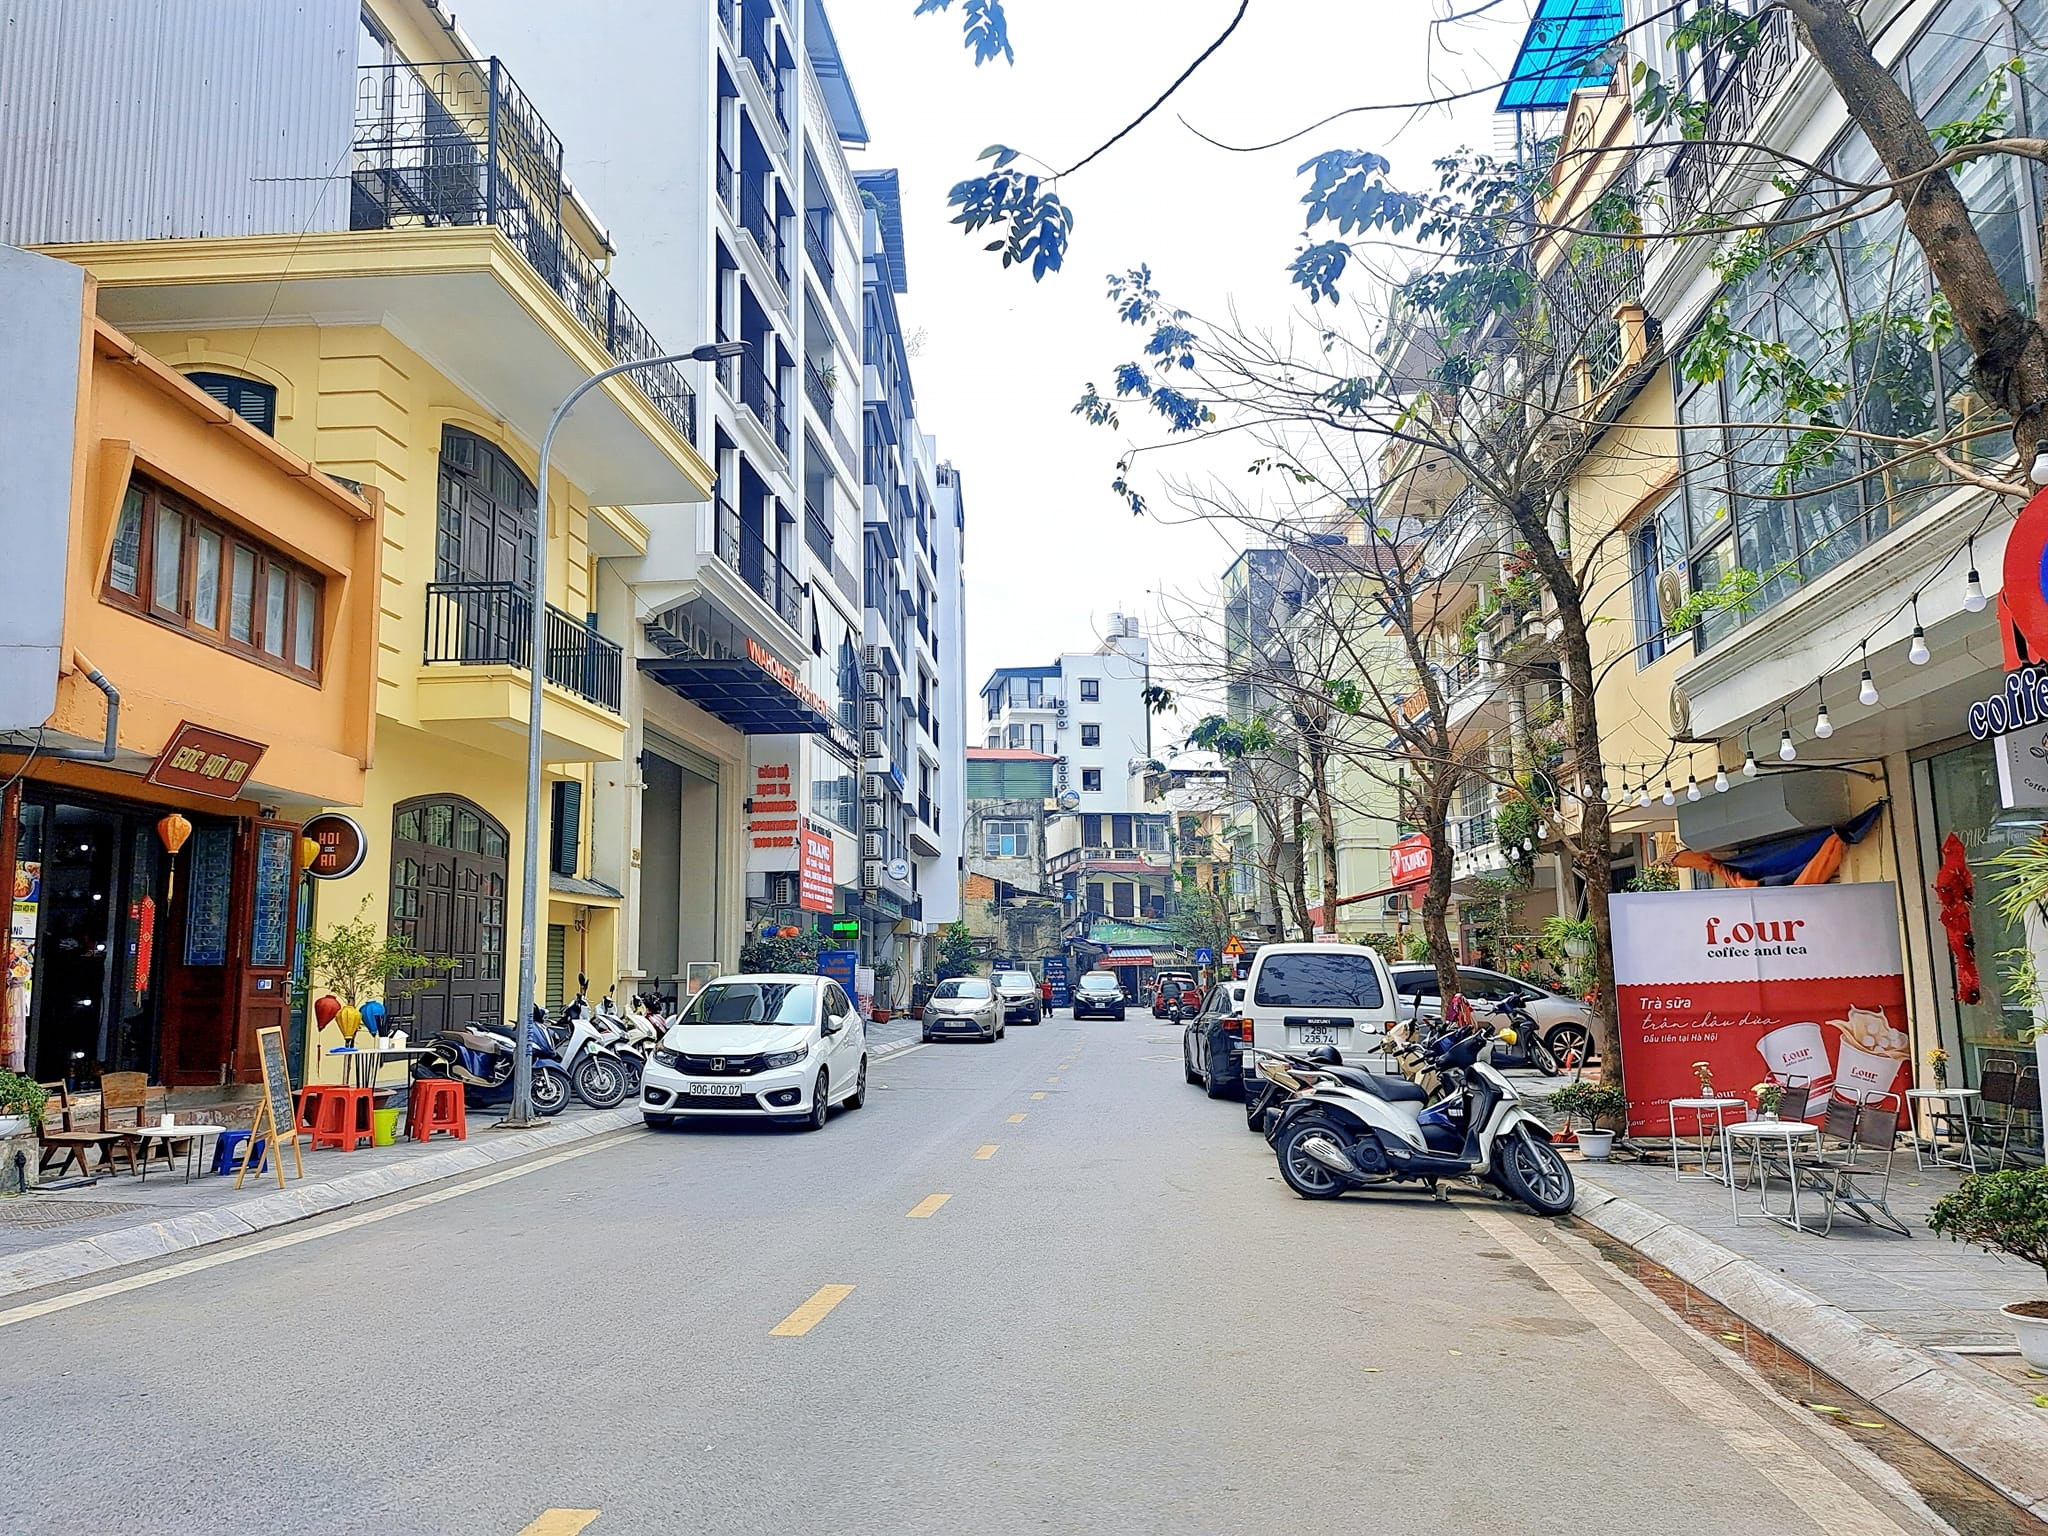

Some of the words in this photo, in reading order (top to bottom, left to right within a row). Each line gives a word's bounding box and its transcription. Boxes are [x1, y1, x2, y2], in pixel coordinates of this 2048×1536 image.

[223, 759, 249, 783] AN
[2023, 776, 2048, 794] Coffe
[319, 832, 340, 845] HOI
[320, 854, 337, 867] AN
[1706, 916, 1805, 945] f.our
[1707, 946, 1750, 959] coffee
[1754, 945, 1781, 957] and
[1786, 945, 1807, 955] tea
[1640, 996, 1662, 1010] Trà
[1665, 996, 1692, 1010] sữa
[1691, 1032, 1702, 1043] Hà
[1704, 1032, 1718, 1043] Nội
[1782, 1046, 1810, 1064] f.our
[1851, 1066, 1879, 1080] f.our
[691, 1084, 740, 1096] 30G-002.07
[1713, 1089, 1736, 1099] .our
